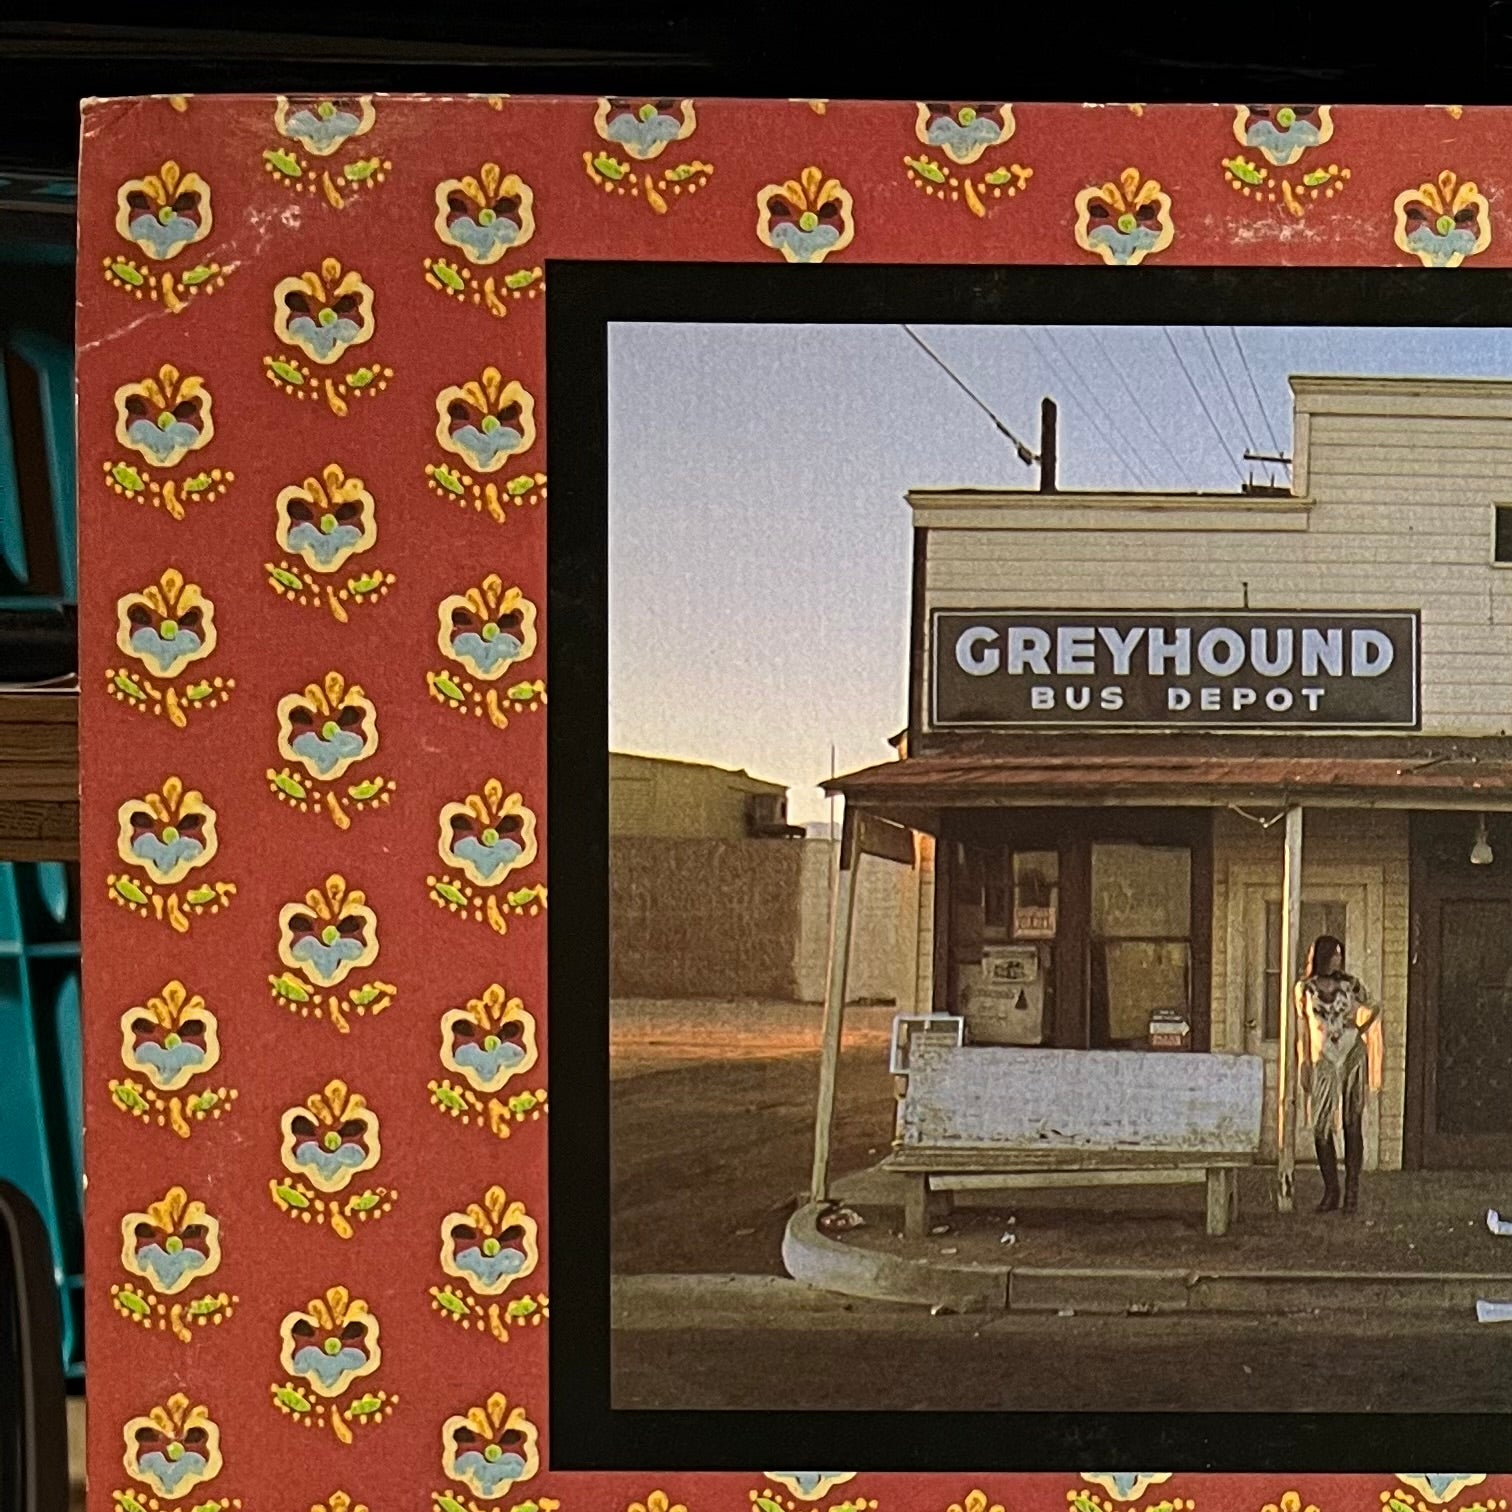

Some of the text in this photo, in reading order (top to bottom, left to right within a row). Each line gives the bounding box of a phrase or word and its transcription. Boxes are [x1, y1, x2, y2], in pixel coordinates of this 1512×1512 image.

[954, 625, 1395, 678] GREYHOUND
[1030, 685, 1327, 713] BUS DEPOT
